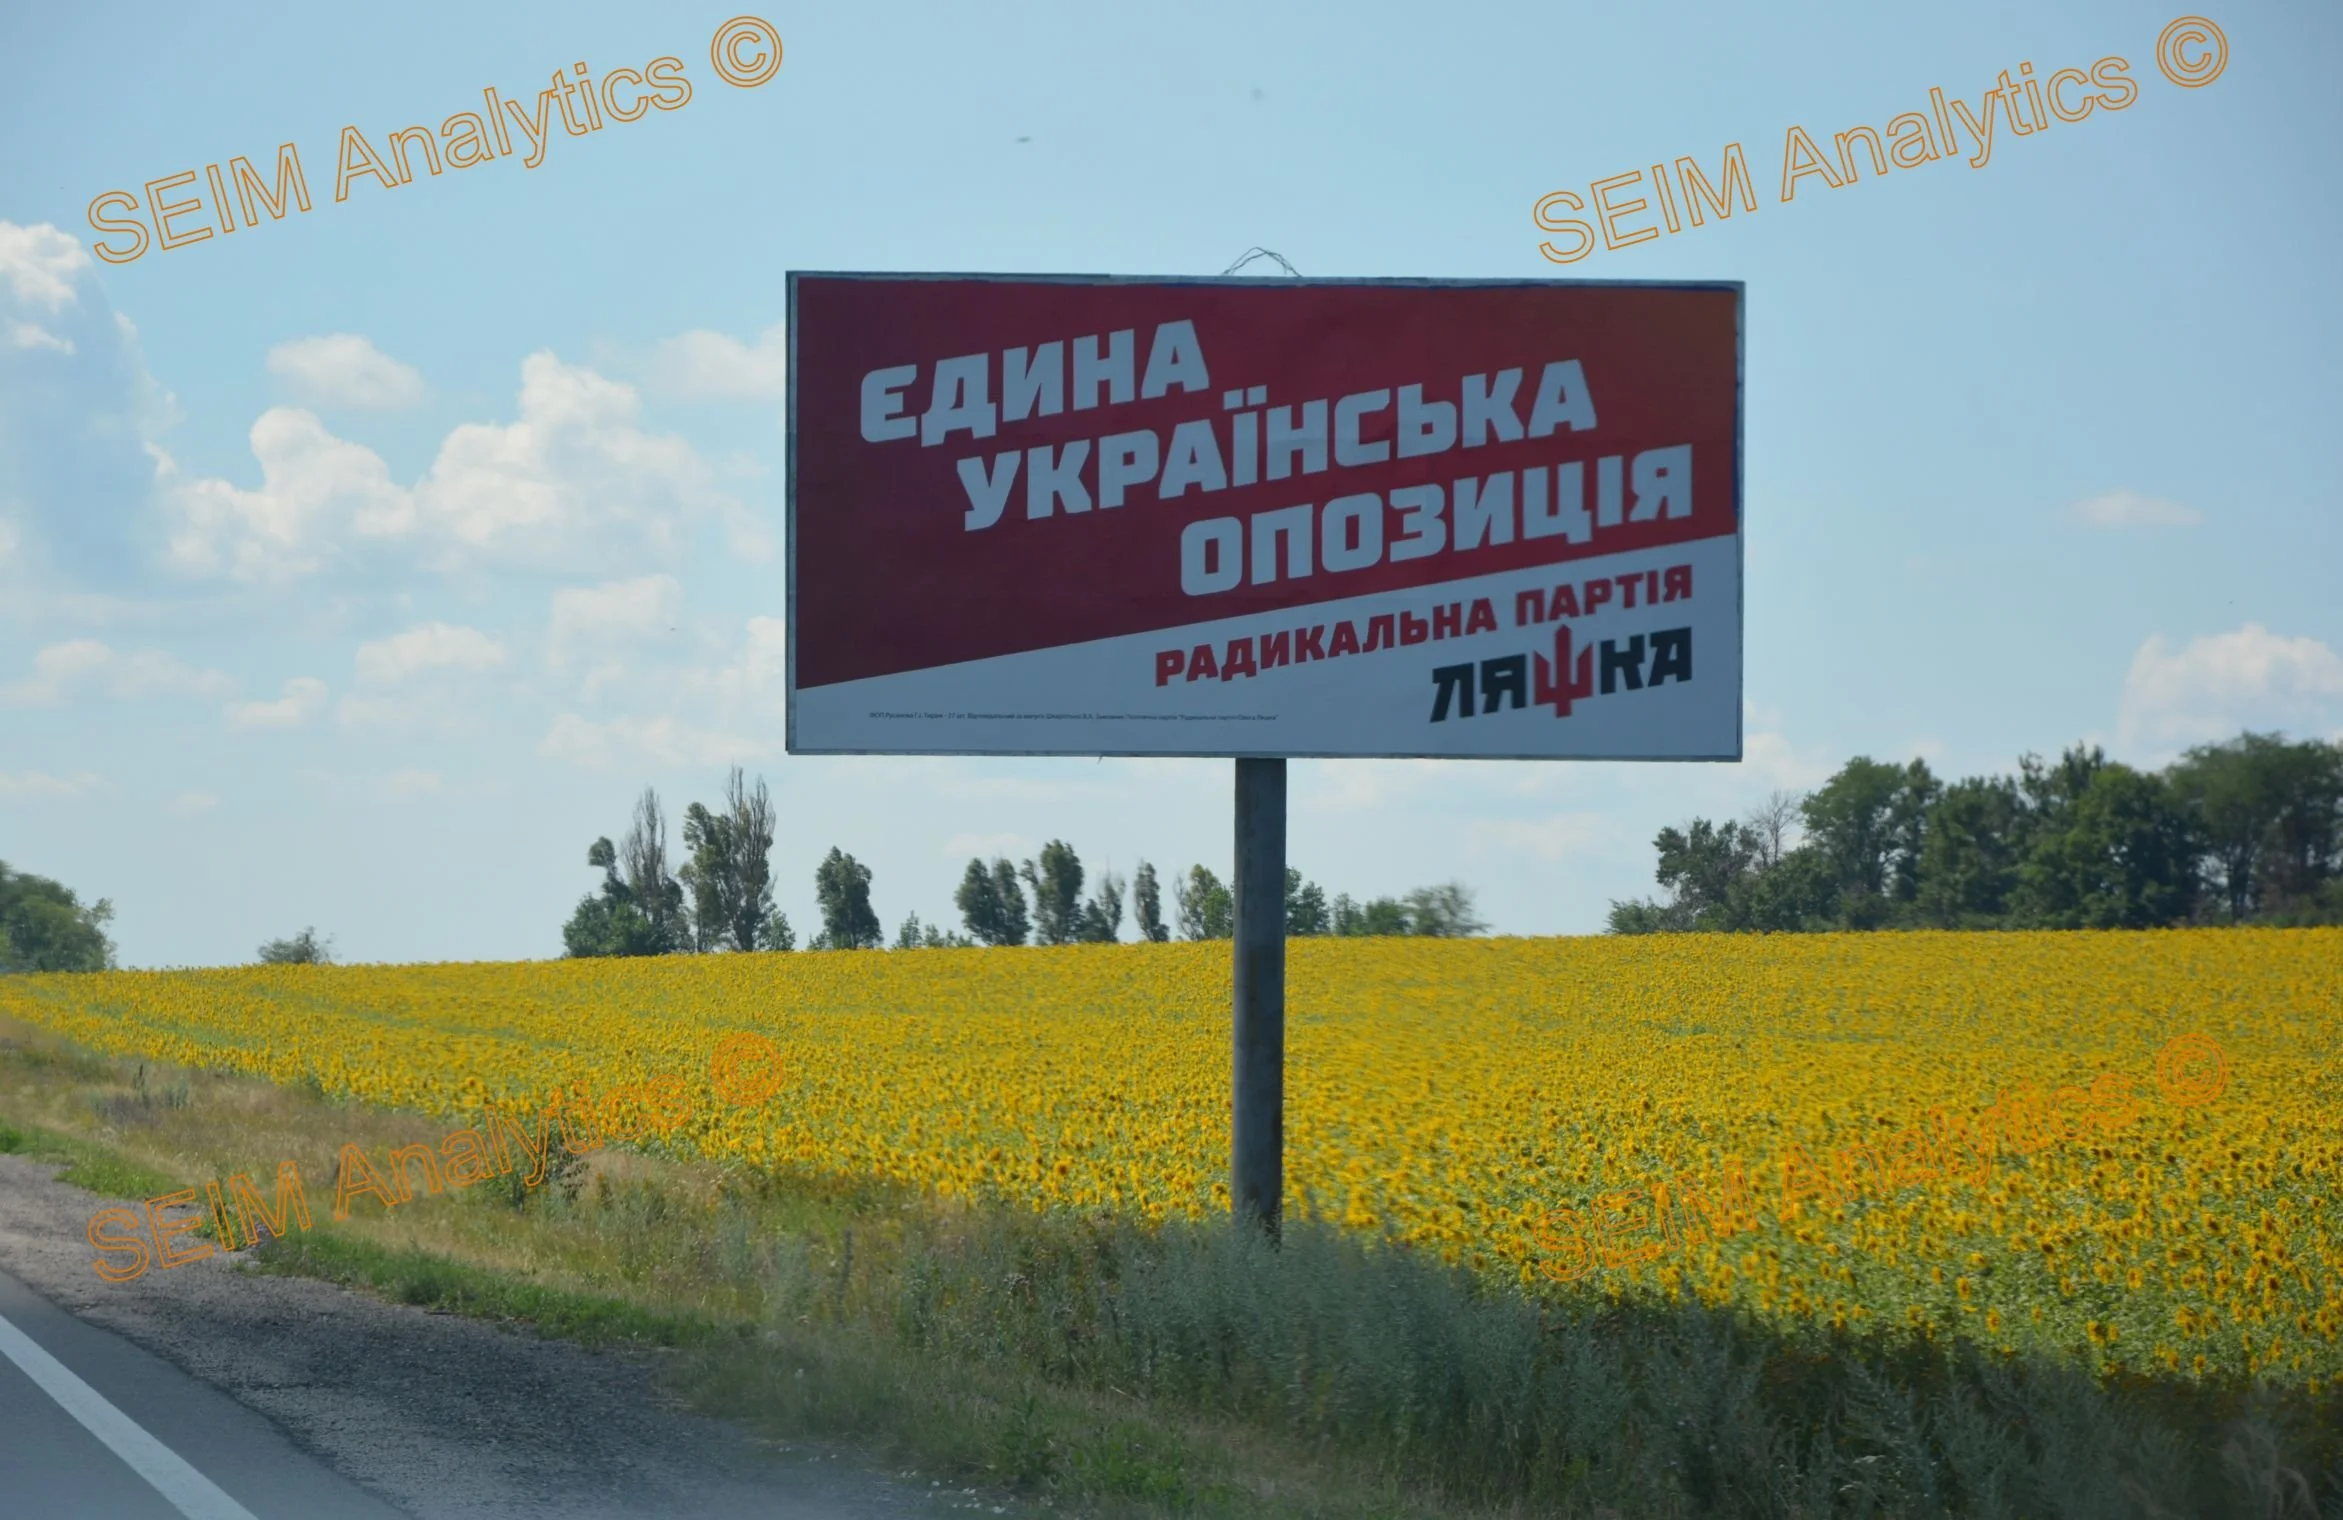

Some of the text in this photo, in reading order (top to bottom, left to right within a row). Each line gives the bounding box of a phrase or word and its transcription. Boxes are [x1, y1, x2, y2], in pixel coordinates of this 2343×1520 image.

[859, 318, 1210, 447] ЄДИНА
[956, 358, 1598, 532] УКРАЇНСЬКА
[1180, 443, 1694, 597] ОПОЗИЦІЯ
[1154, 564, 1693, 687] РАДИКАЛЬНА ПАРТІЯ
